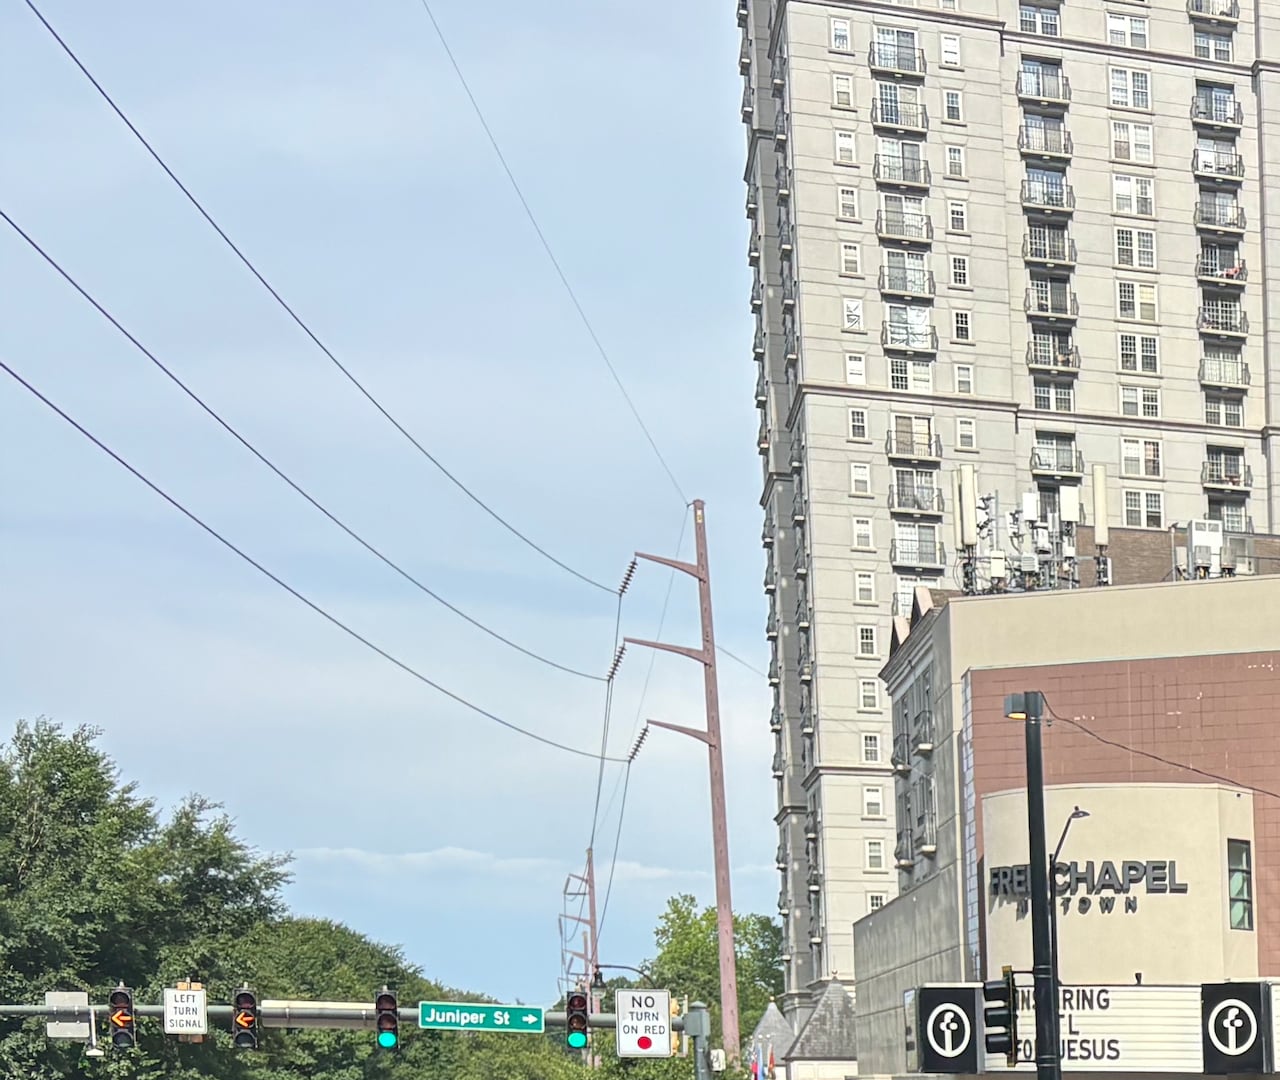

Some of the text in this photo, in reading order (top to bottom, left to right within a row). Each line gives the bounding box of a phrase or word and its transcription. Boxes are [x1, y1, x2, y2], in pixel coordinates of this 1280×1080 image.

[989, 860, 1188, 898] FRE CHAPEL
[174, 994, 196, 1003] LEFT
[631, 995, 656, 1009] NO
[173, 1006, 198, 1016] TURN
[628, 1011, 660, 1022] TURN
[425, 1008, 511, 1026] Juniper St
[169, 1018, 204, 1028] SIGNAL
[622, 1024, 667, 1035] ON RED
